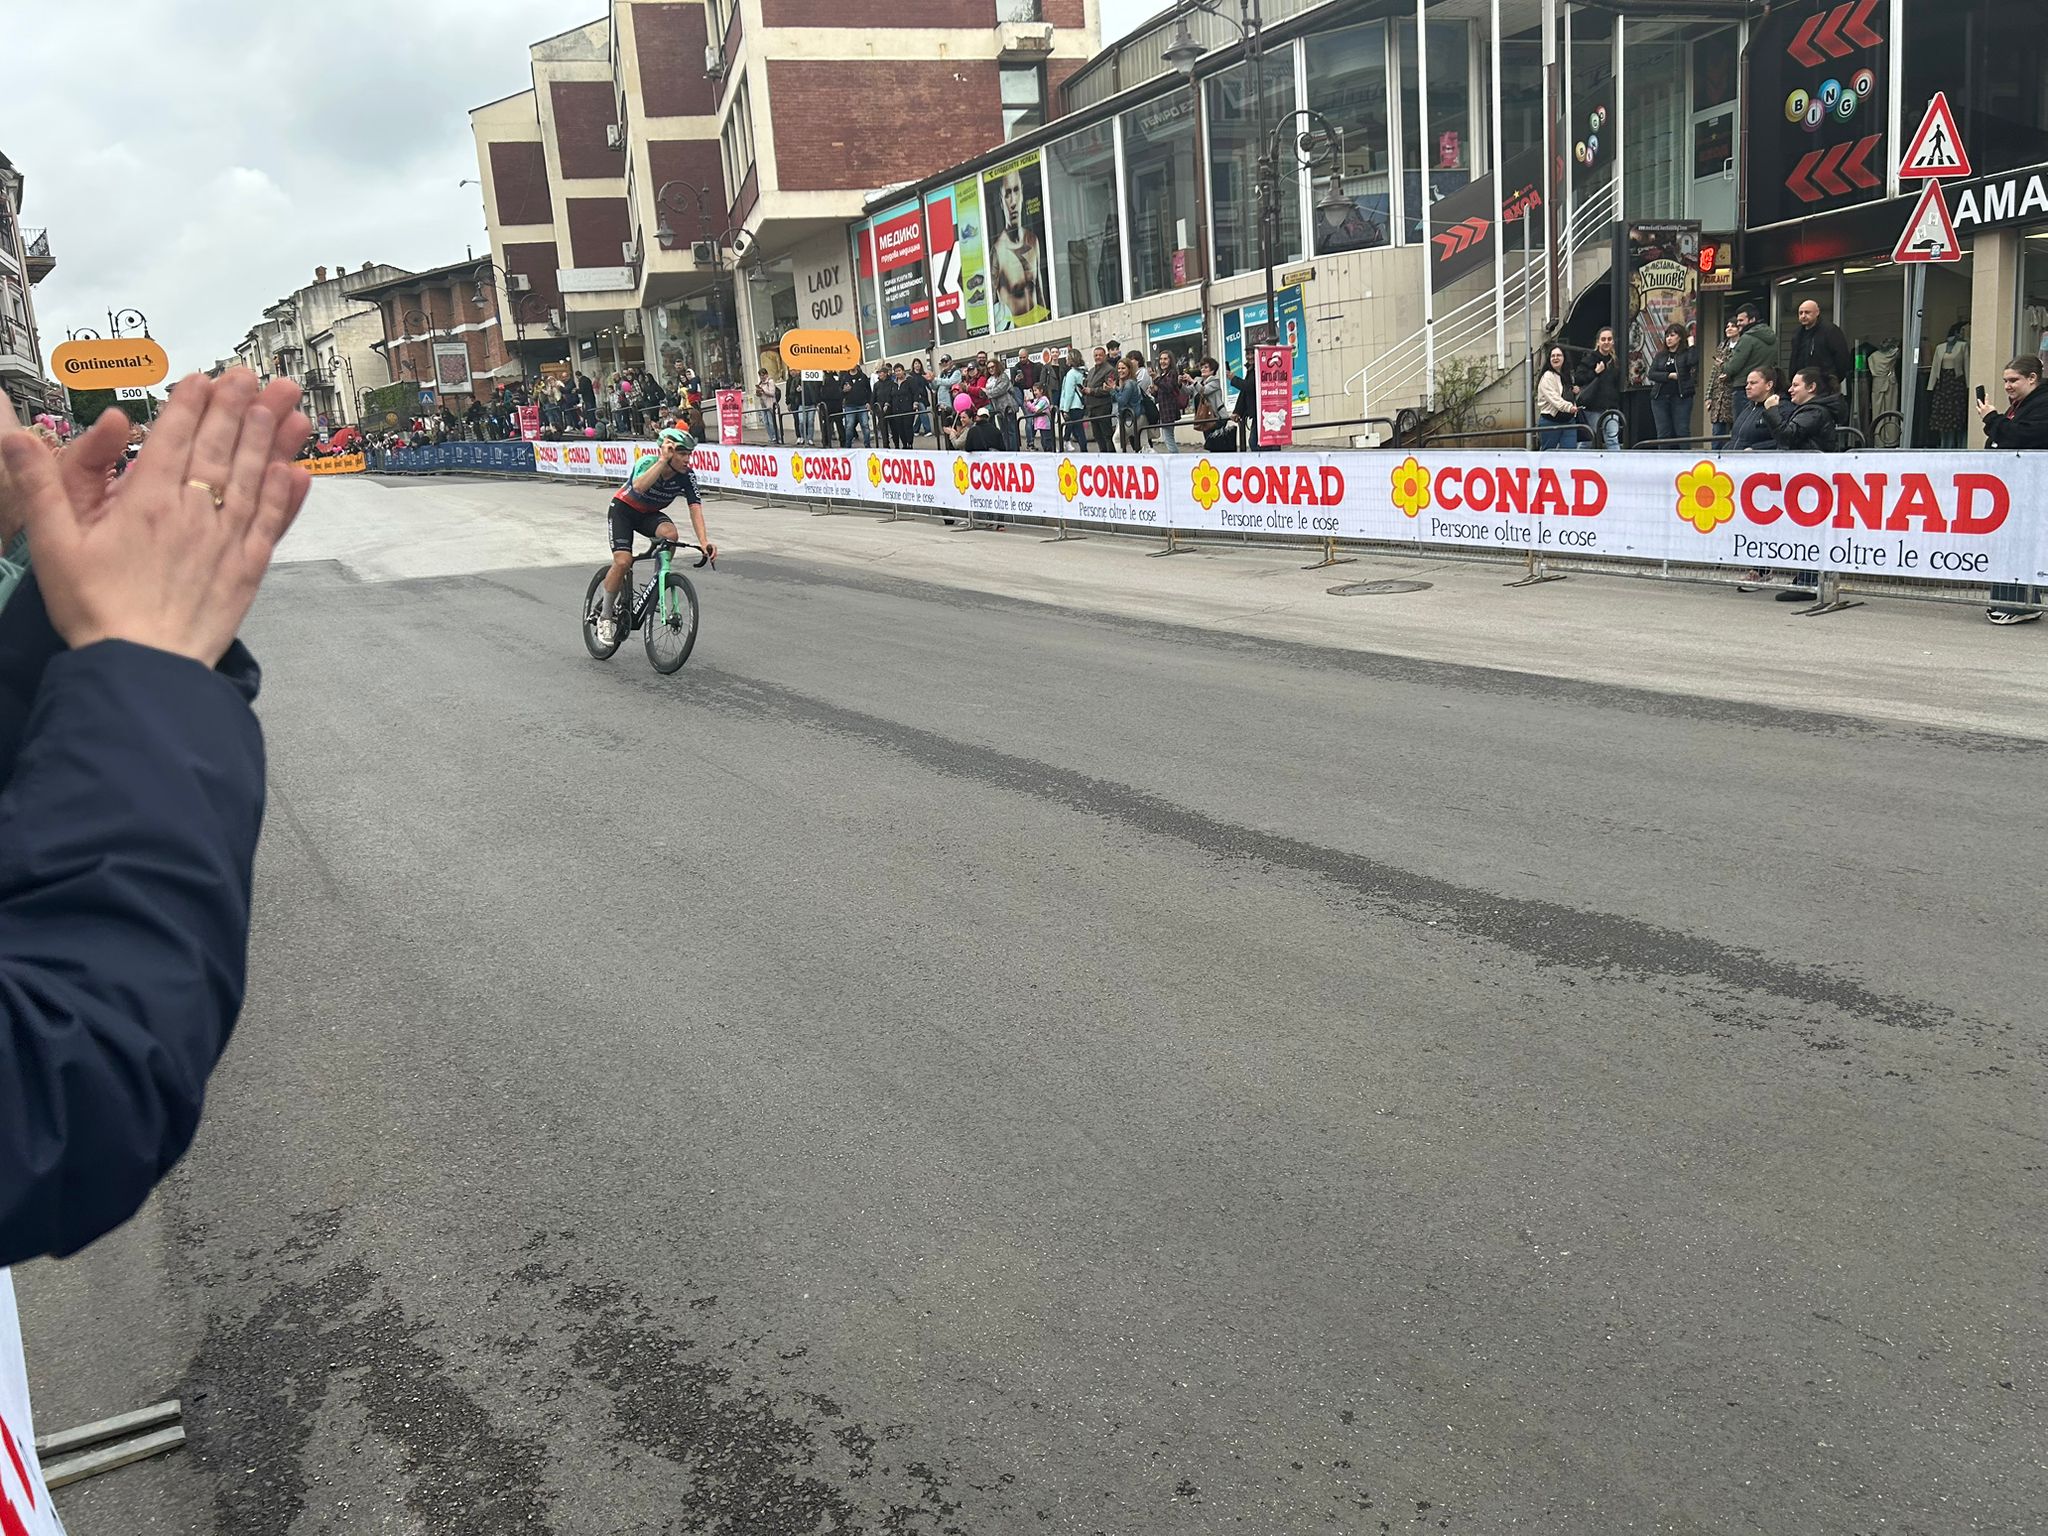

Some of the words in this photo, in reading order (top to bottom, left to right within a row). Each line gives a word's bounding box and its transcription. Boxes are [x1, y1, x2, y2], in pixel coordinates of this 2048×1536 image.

[1142, 105, 1180, 128] TEMPO
[1953, 175, 2048, 228] AMA
[879, 223, 919, 250] МЕДИКО
[808, 265, 839, 293] LADY
[1641, 270, 1685, 289] ХЪШОВЕ
[811, 295, 843, 320] GOLD
[1225, 331, 1241, 343] VELO
[790, 343, 842, 356] Continental
[65, 356, 141, 373] Continental
[805, 371, 819, 379] 500
[122, 388, 142, 398] 500
[568, 447, 590, 464] CONAD
[603, 447, 627, 465] CONAD
[689, 449, 720, 472] CONAD
[740, 454, 778, 477] CONAD
[804, 457, 852, 481] CONAD
[882, 458, 935, 487] CONAD
[970, 462, 1035, 494] CONAD
[1080, 464, 1159, 501] CONAD
[1222, 466, 1345, 506] CONAD
[1434, 466, 1608, 517] CONAD
[882, 487, 902, 499] Persone
[902, 488, 915, 500] oltre
[916, 489, 922, 501] le
[922, 493, 935, 503] cose
[970, 494, 993, 509] Persone
[994, 496, 1009, 510] oltre
[1010, 497, 1017, 510] le
[1018, 500, 1033, 512] cose
[1740, 472, 2010, 535] CONAD
[1079, 502, 1107, 518] Persone
[1109, 503, 1127, 520] oltre
[1129, 504, 1136, 520] le
[1139, 509, 1156, 521] cose
[1221, 510, 1262, 528] Persone
[1267, 510, 1293, 529] oltre
[1298, 511, 1308, 530] le
[1312, 516, 1339, 531] cose
[1431, 518, 1489, 540] Persone
[1495, 520, 1531, 542] oltre
[1538, 522, 1552, 544] le
[1558, 528, 1596, 547] cose
[1733, 534, 1820, 563] Persone
[1829, 538, 1886, 567] oltre
[1898, 538, 1918, 568] le
[1929, 550, 1989, 573] cose
